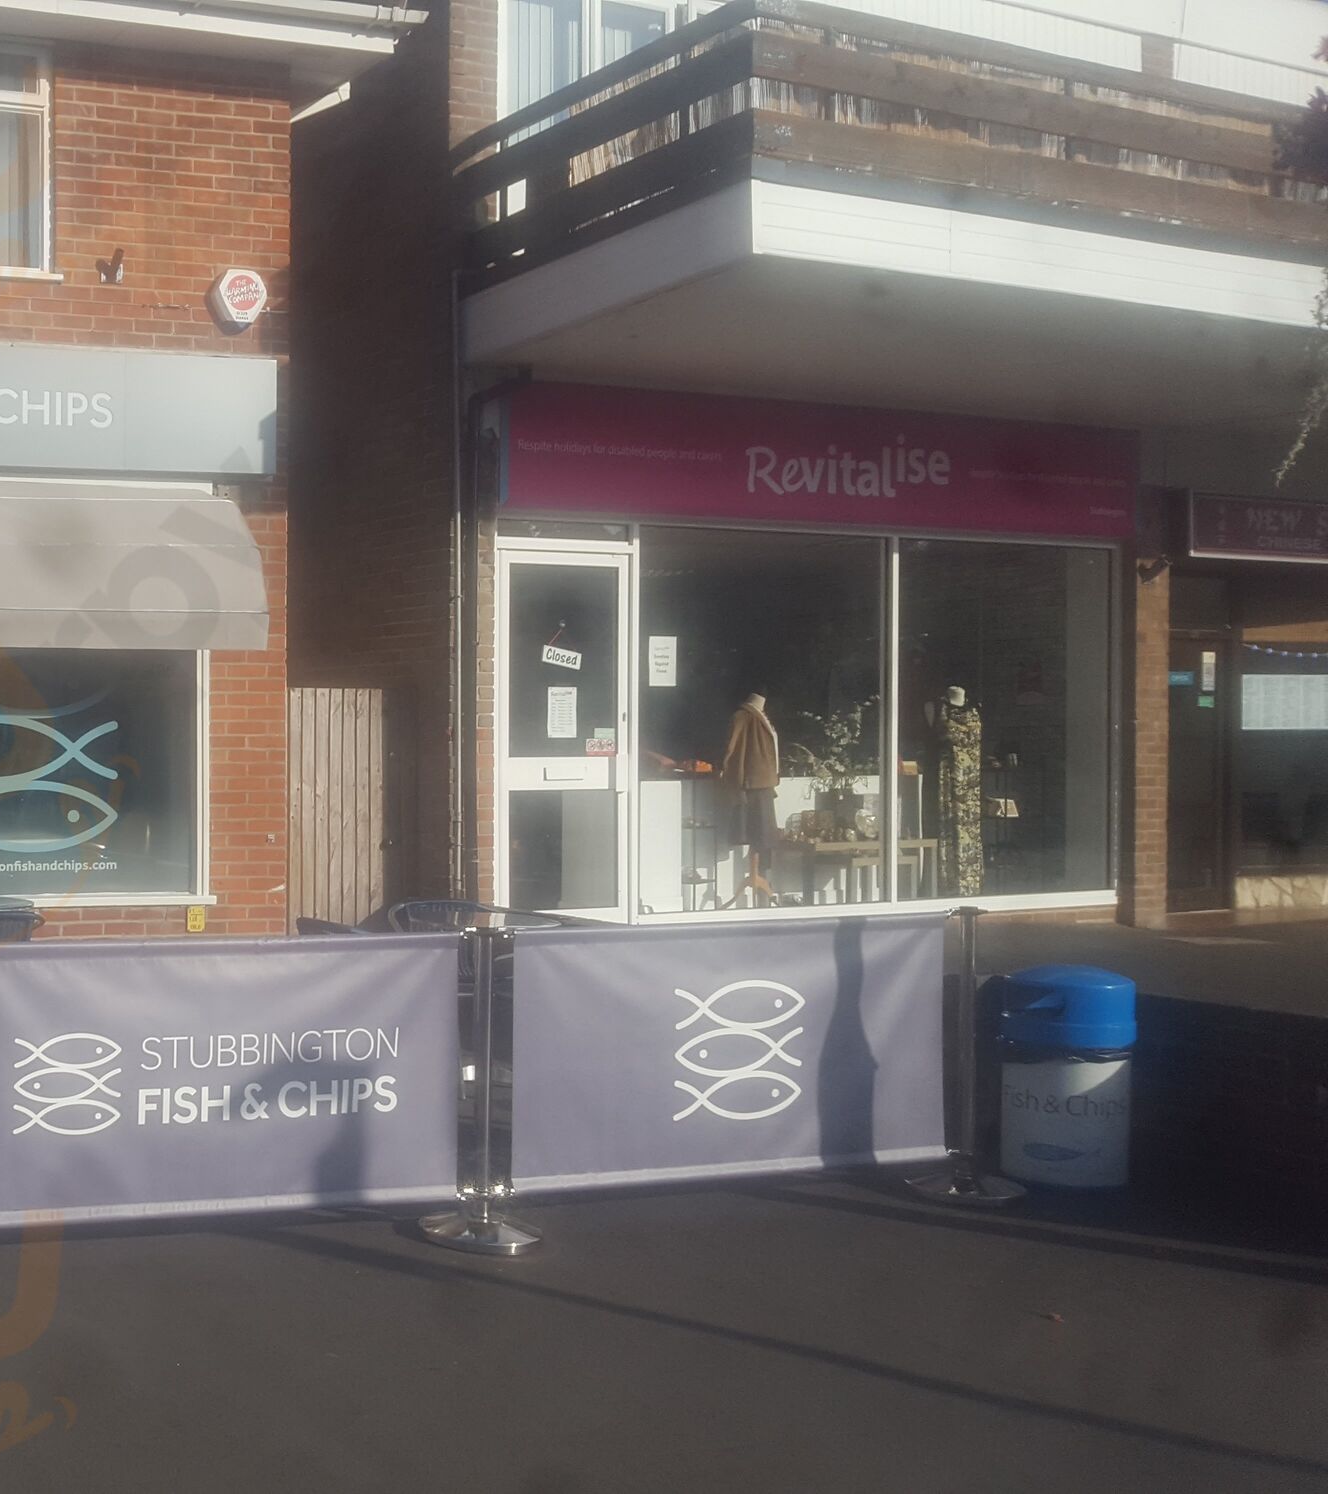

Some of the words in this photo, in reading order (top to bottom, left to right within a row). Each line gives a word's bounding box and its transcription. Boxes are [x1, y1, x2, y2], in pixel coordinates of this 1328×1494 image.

[746, 434, 951, 498] Revitalise
[546, 648, 578, 666] Closed
[141, 1026, 401, 1071] STUBBINGTON
[138, 1086, 231, 1126] FISH
[240, 1083, 269, 1121] &
[277, 1074, 398, 1117] CHIPS
[1043, 1095, 1060, 1113] &
